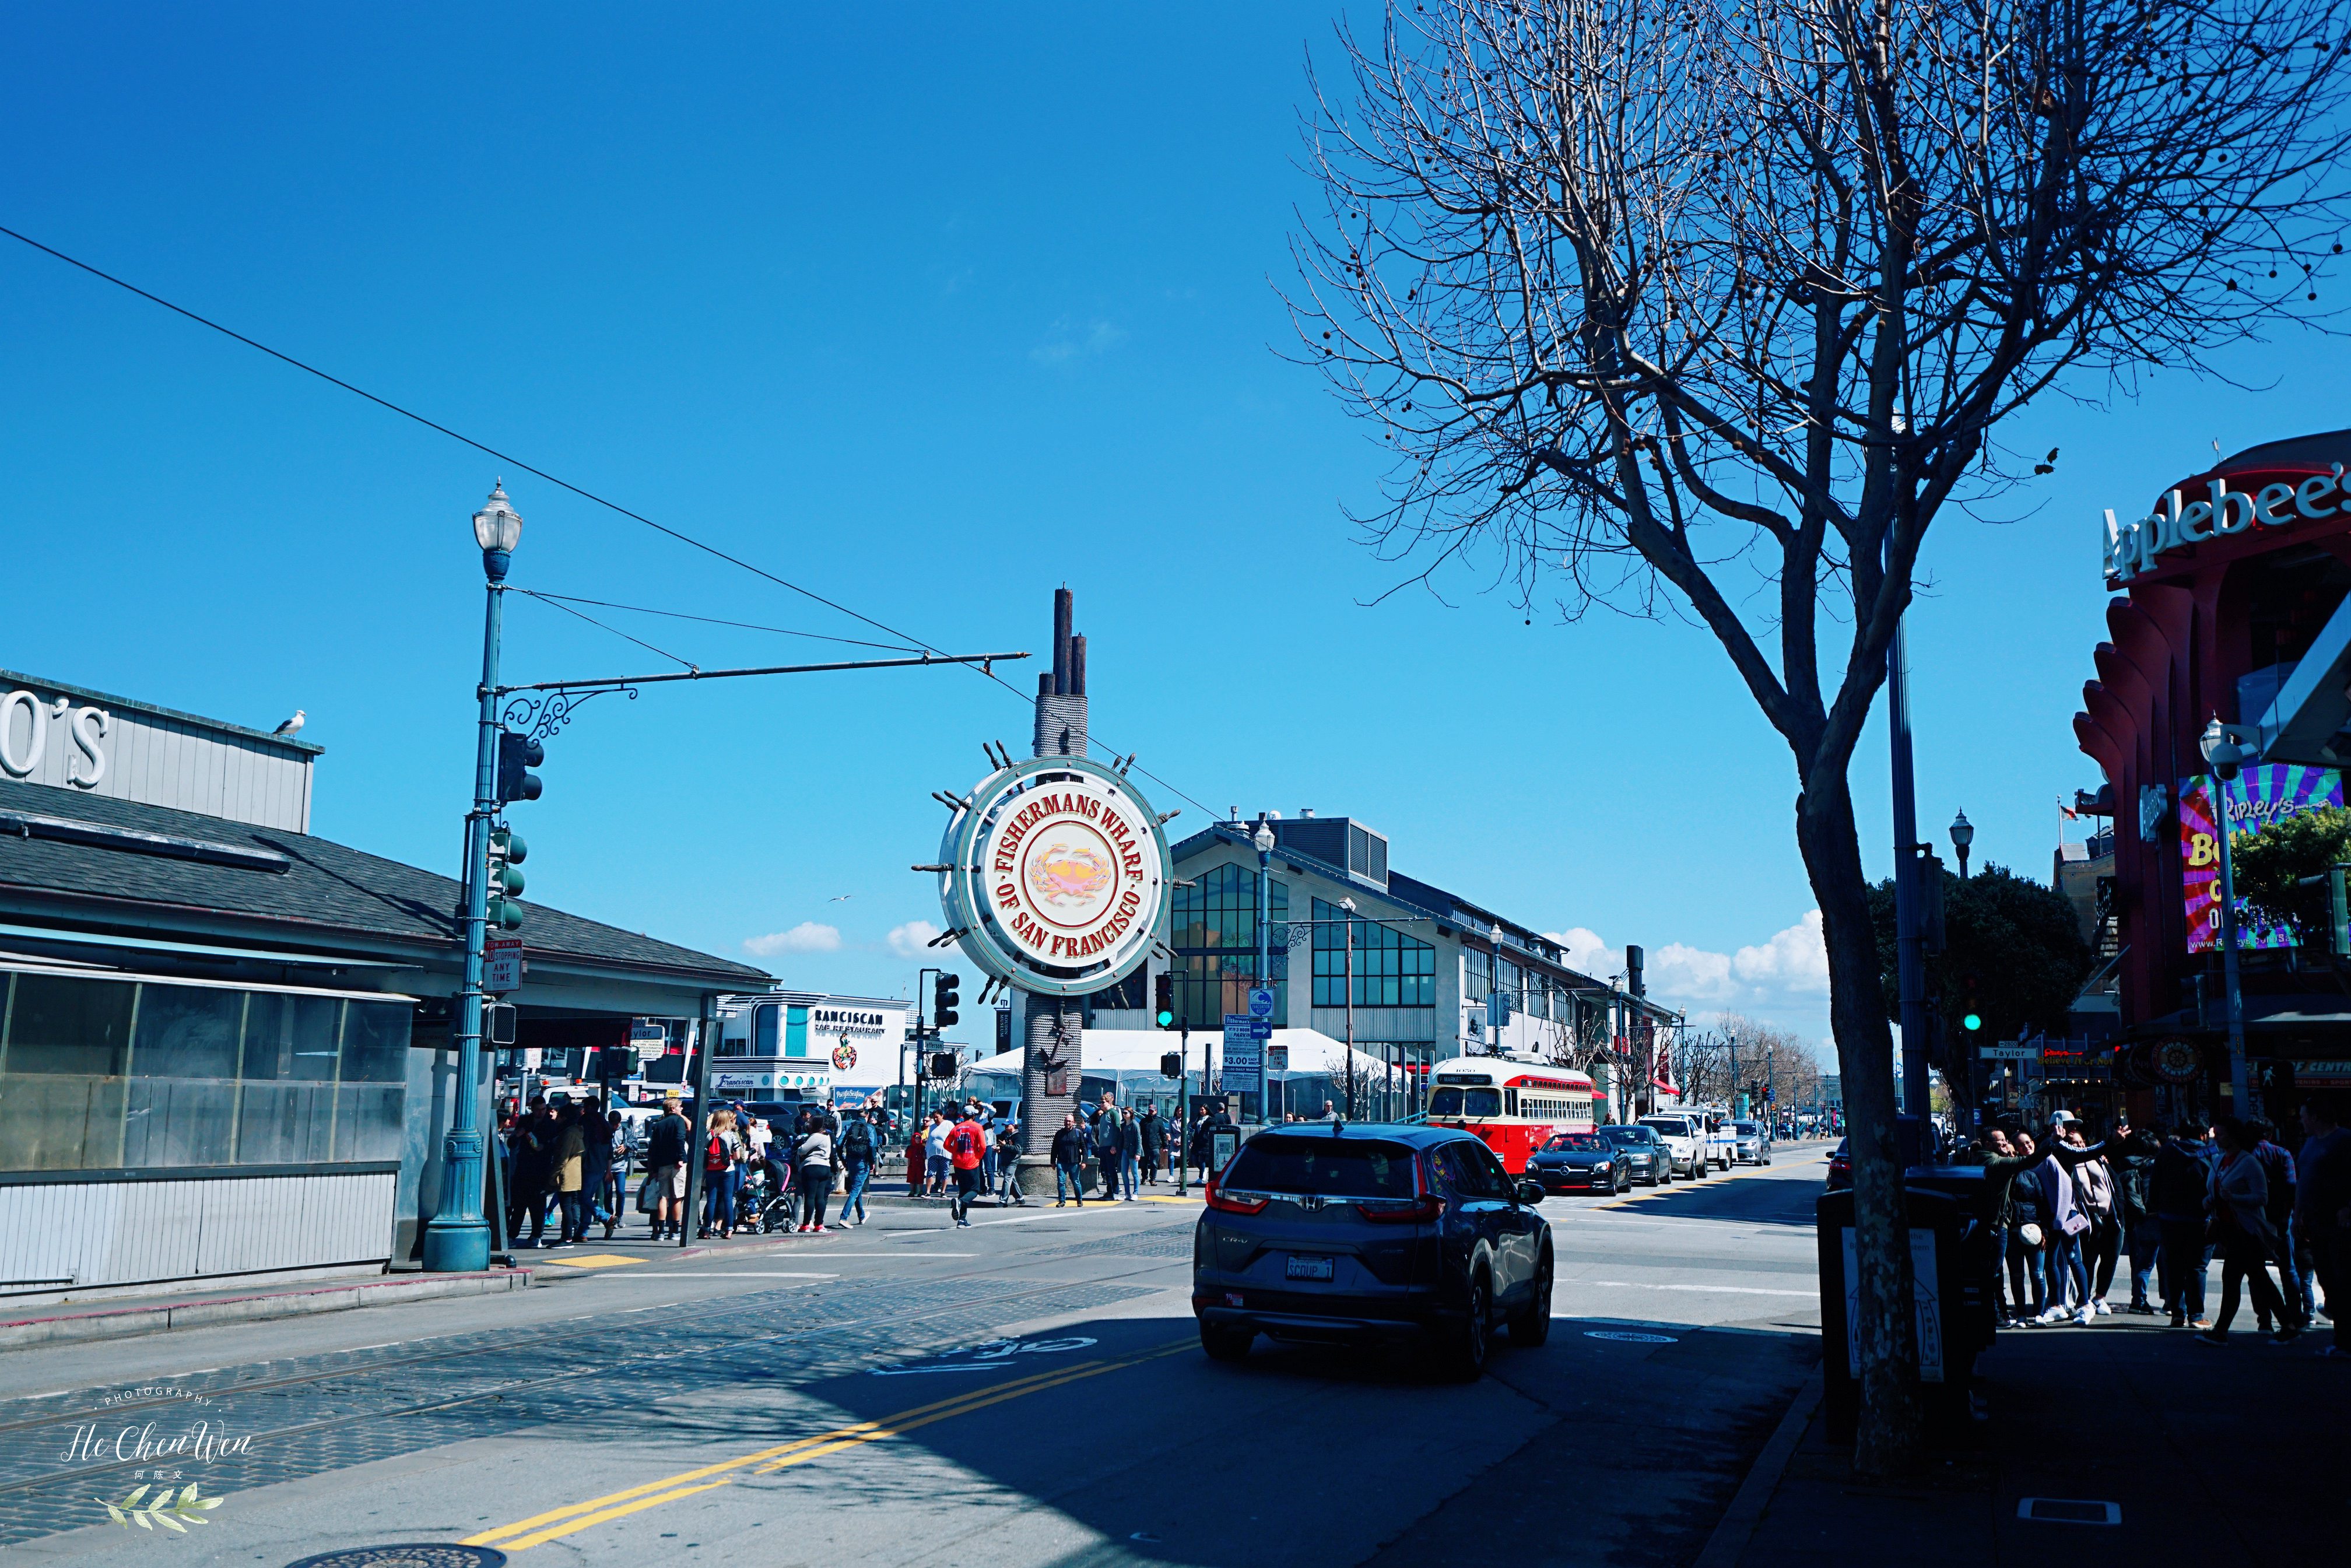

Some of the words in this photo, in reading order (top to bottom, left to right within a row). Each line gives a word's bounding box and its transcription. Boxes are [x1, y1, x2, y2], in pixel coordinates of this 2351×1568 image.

[994, 793, 1101, 873] FISHERMANS
[1100, 806, 1143, 883] WHARF
[996, 883, 1020, 910] OF
[1011, 911, 1050, 949] SAN
[1050, 890, 1141, 957] FRANCISCO
[485, 950, 494, 961] NO
[495, 951, 520, 961] STOPPING
[494, 963, 510, 971] ANY
[492, 973, 511, 982] TIME
[815, 1009, 883, 1025] RANCISCAN
[633, 1029, 651, 1040] ylor
[833, 1025, 886, 1034] RESTAURANT
[1992, 1049, 2026, 1058] Taylor
[1224, 1057, 1248, 1065] $3.00
[2037, 1057, 2070, 1065] Believe
[715, 1074, 754, 1088] Franciscan
[849, 1089, 865, 1100] Seafood
